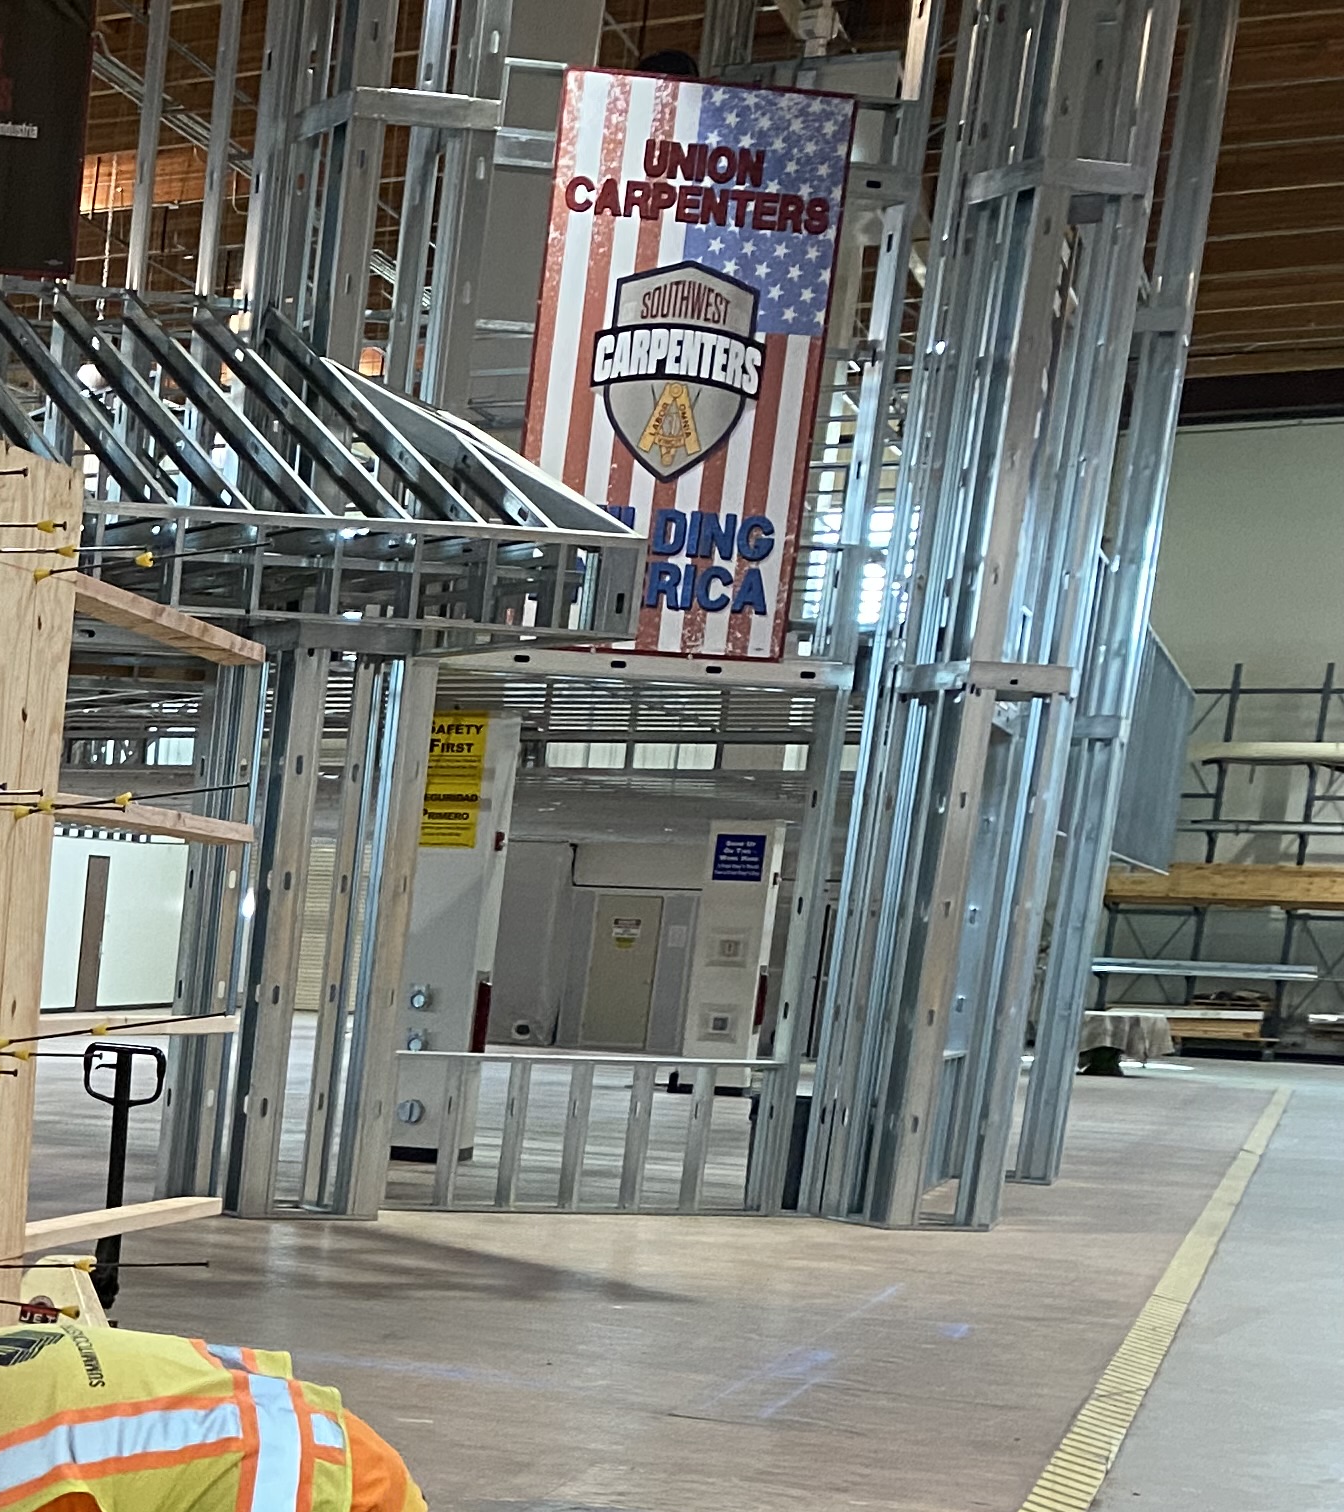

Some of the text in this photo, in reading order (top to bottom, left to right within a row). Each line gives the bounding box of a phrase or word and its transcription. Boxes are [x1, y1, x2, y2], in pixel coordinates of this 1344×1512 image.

[642, 138, 765, 189] UNION
[564, 175, 830, 236] CARPENTERS
[640, 279, 732, 327] SOUTHWEST
[592, 328, 763, 396] CARPENTERS
[649, 402, 668, 437] LABOR
[643, 561, 768, 616] RICA
[429, 738, 474, 753] FIRST
[20, 1311, 57, 1324] JET
